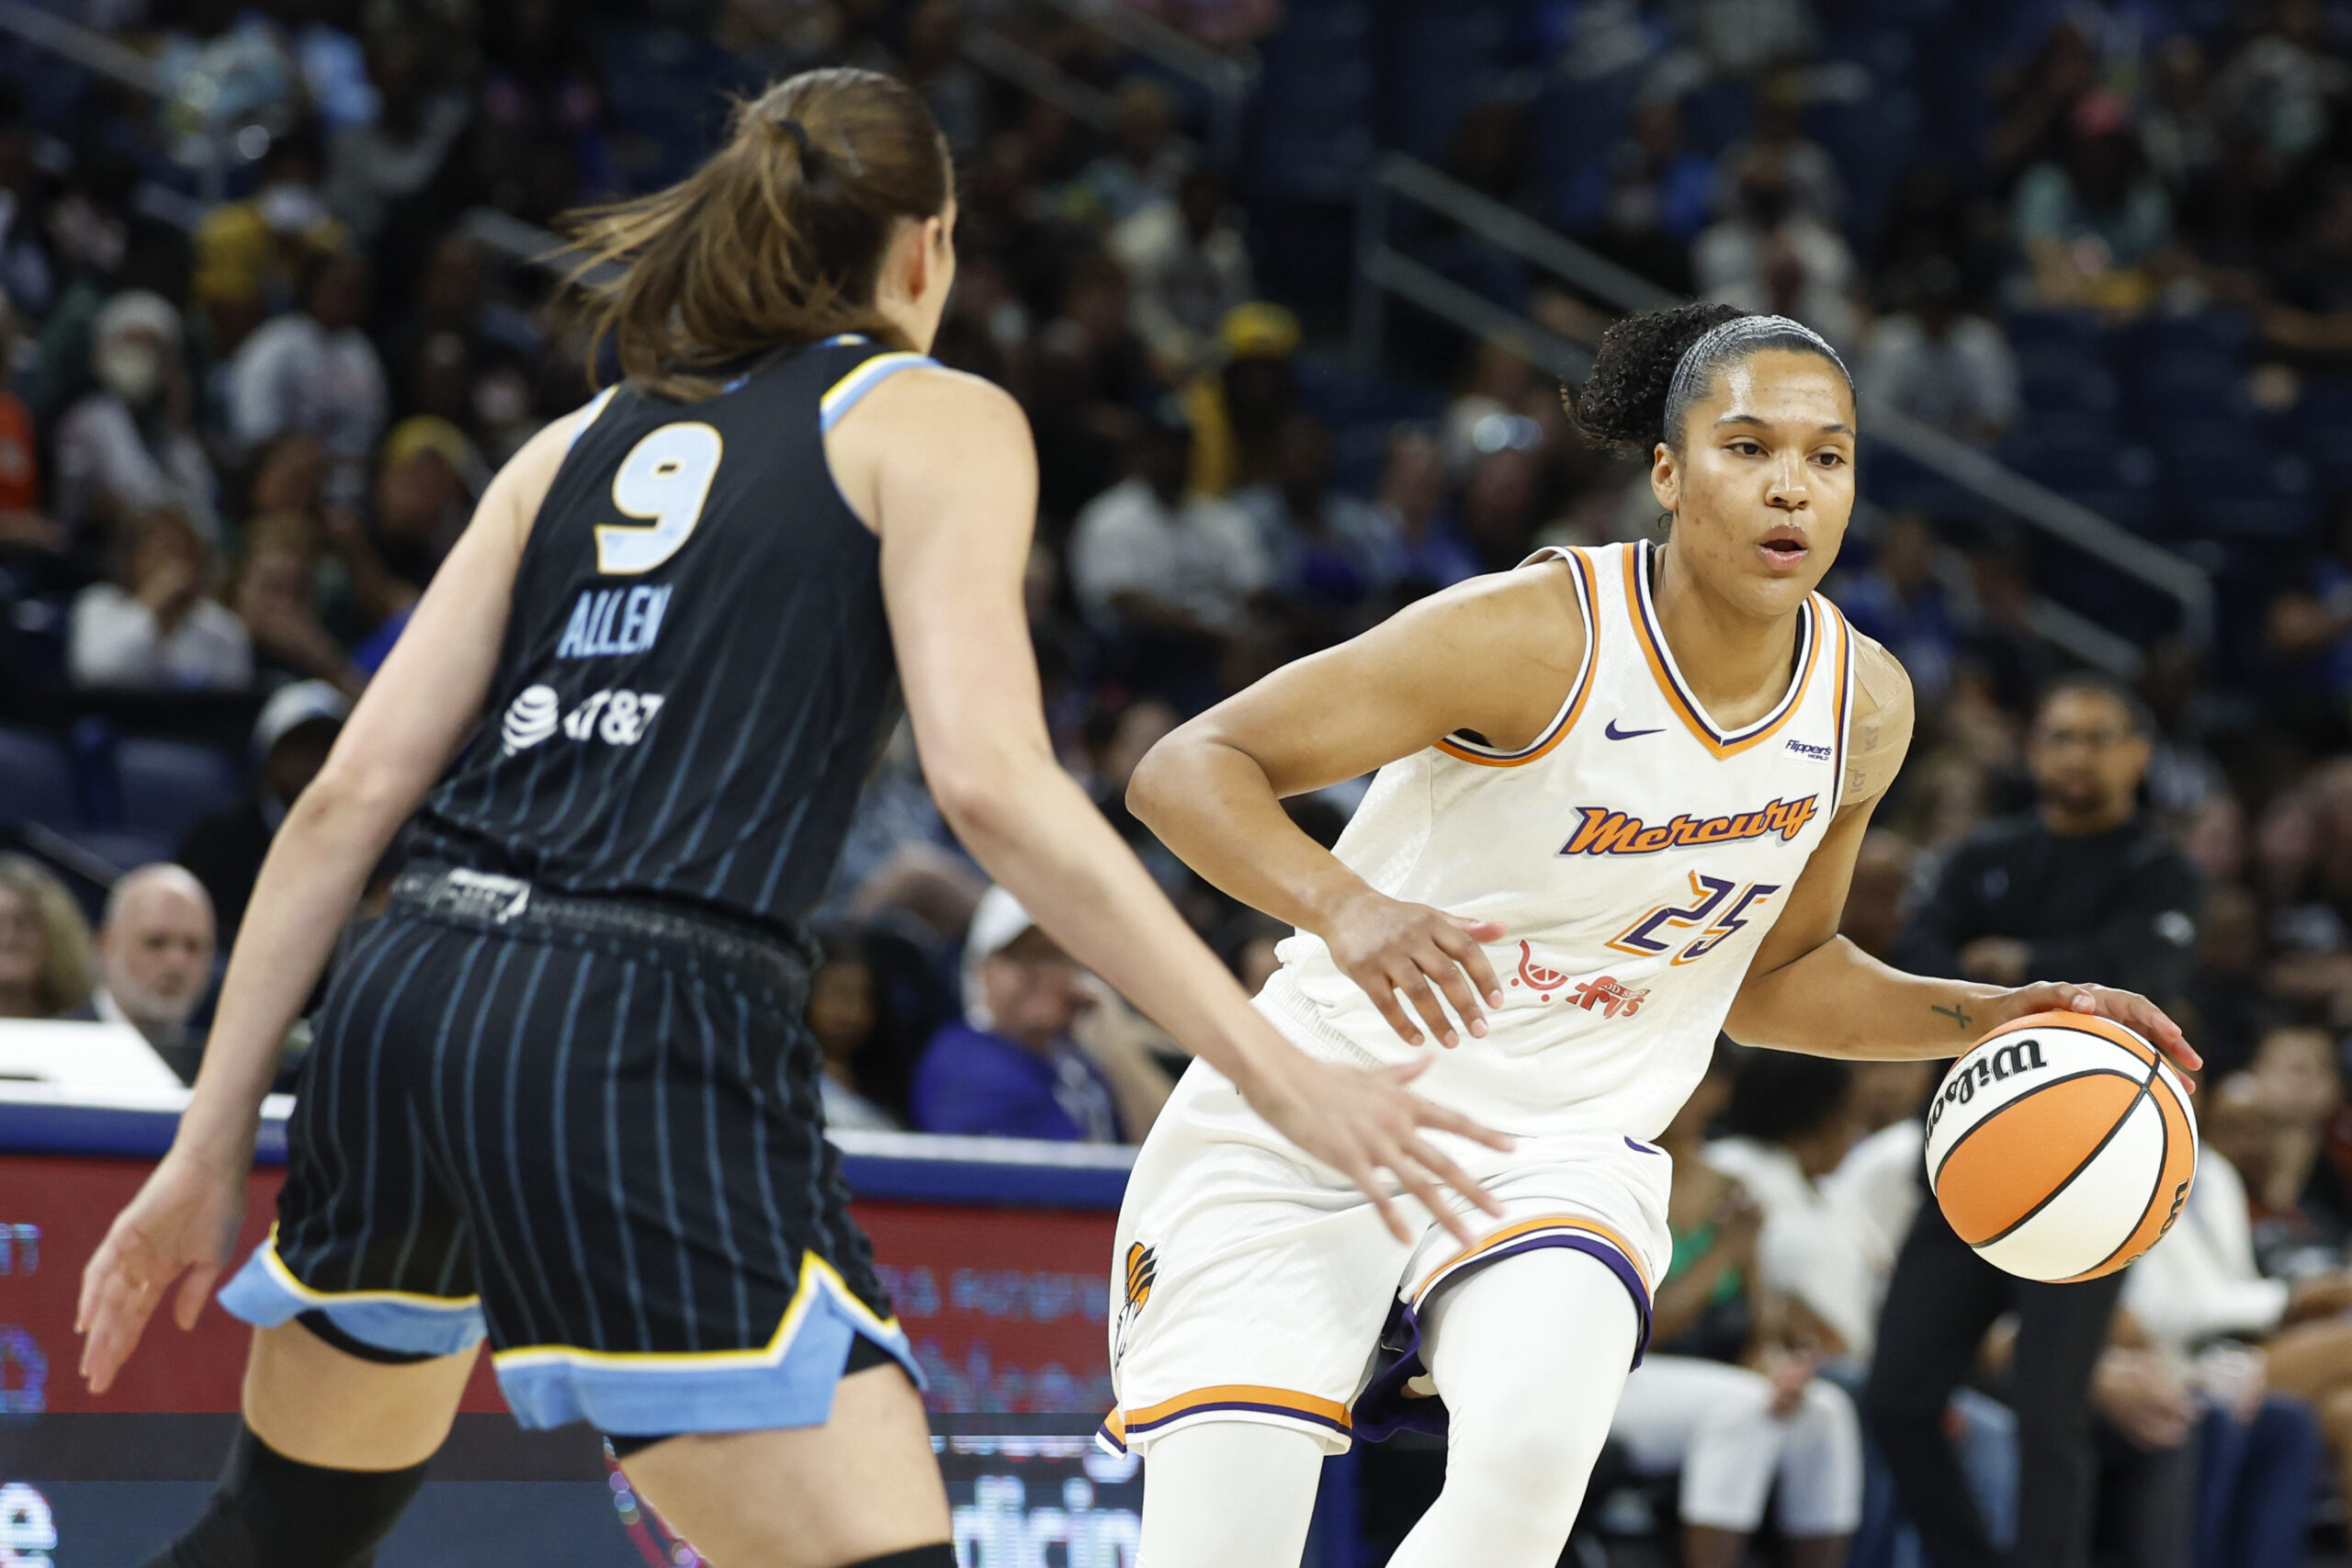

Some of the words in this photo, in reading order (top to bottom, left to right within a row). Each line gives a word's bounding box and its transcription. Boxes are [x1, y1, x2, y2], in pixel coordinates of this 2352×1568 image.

[594, 421, 724, 575] 9
[556, 583, 673, 659] ALLEN
[1556, 793, 1819, 856] Mercury
[1604, 869, 1782, 967] 25
[1926, 1039, 2048, 1150] Wilson
